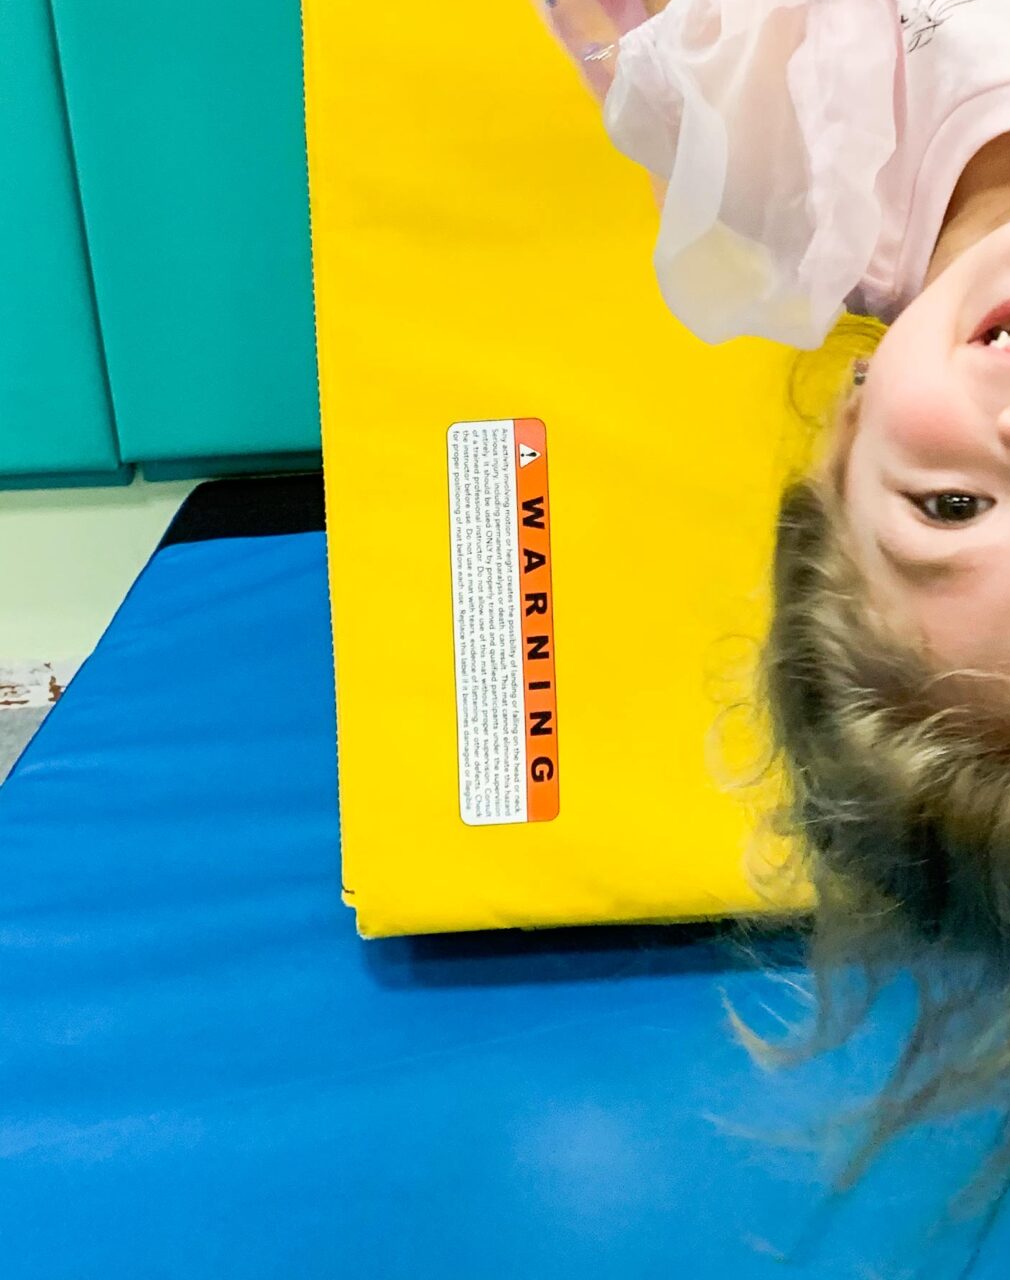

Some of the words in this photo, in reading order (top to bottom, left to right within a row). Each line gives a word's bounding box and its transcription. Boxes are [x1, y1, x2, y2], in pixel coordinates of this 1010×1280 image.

[500, 428, 508, 442] Any
[500, 444, 509, 471] activity
[452, 472, 461, 514] positioning
[472, 476, 481, 522] professional
[491, 482, 501, 516] including
[501, 473, 510, 507] involving
[493, 518, 502, 560] permanent
[504, 548, 513, 572] height
[485, 566, 494, 599] properly
[494, 562, 503, 595] paralysis
[457, 609, 466, 640] Replace
[506, 619, 516, 657] possibility
[521, 496, 553, 782] WARNING
[488, 648, 497, 681] qualified
[508, 669, 517, 698] landing
[489, 684, 498, 729] participants
[510, 710, 518, 734] falling
[461, 730, 470, 767] damaged
[492, 773, 501, 816] supervision
